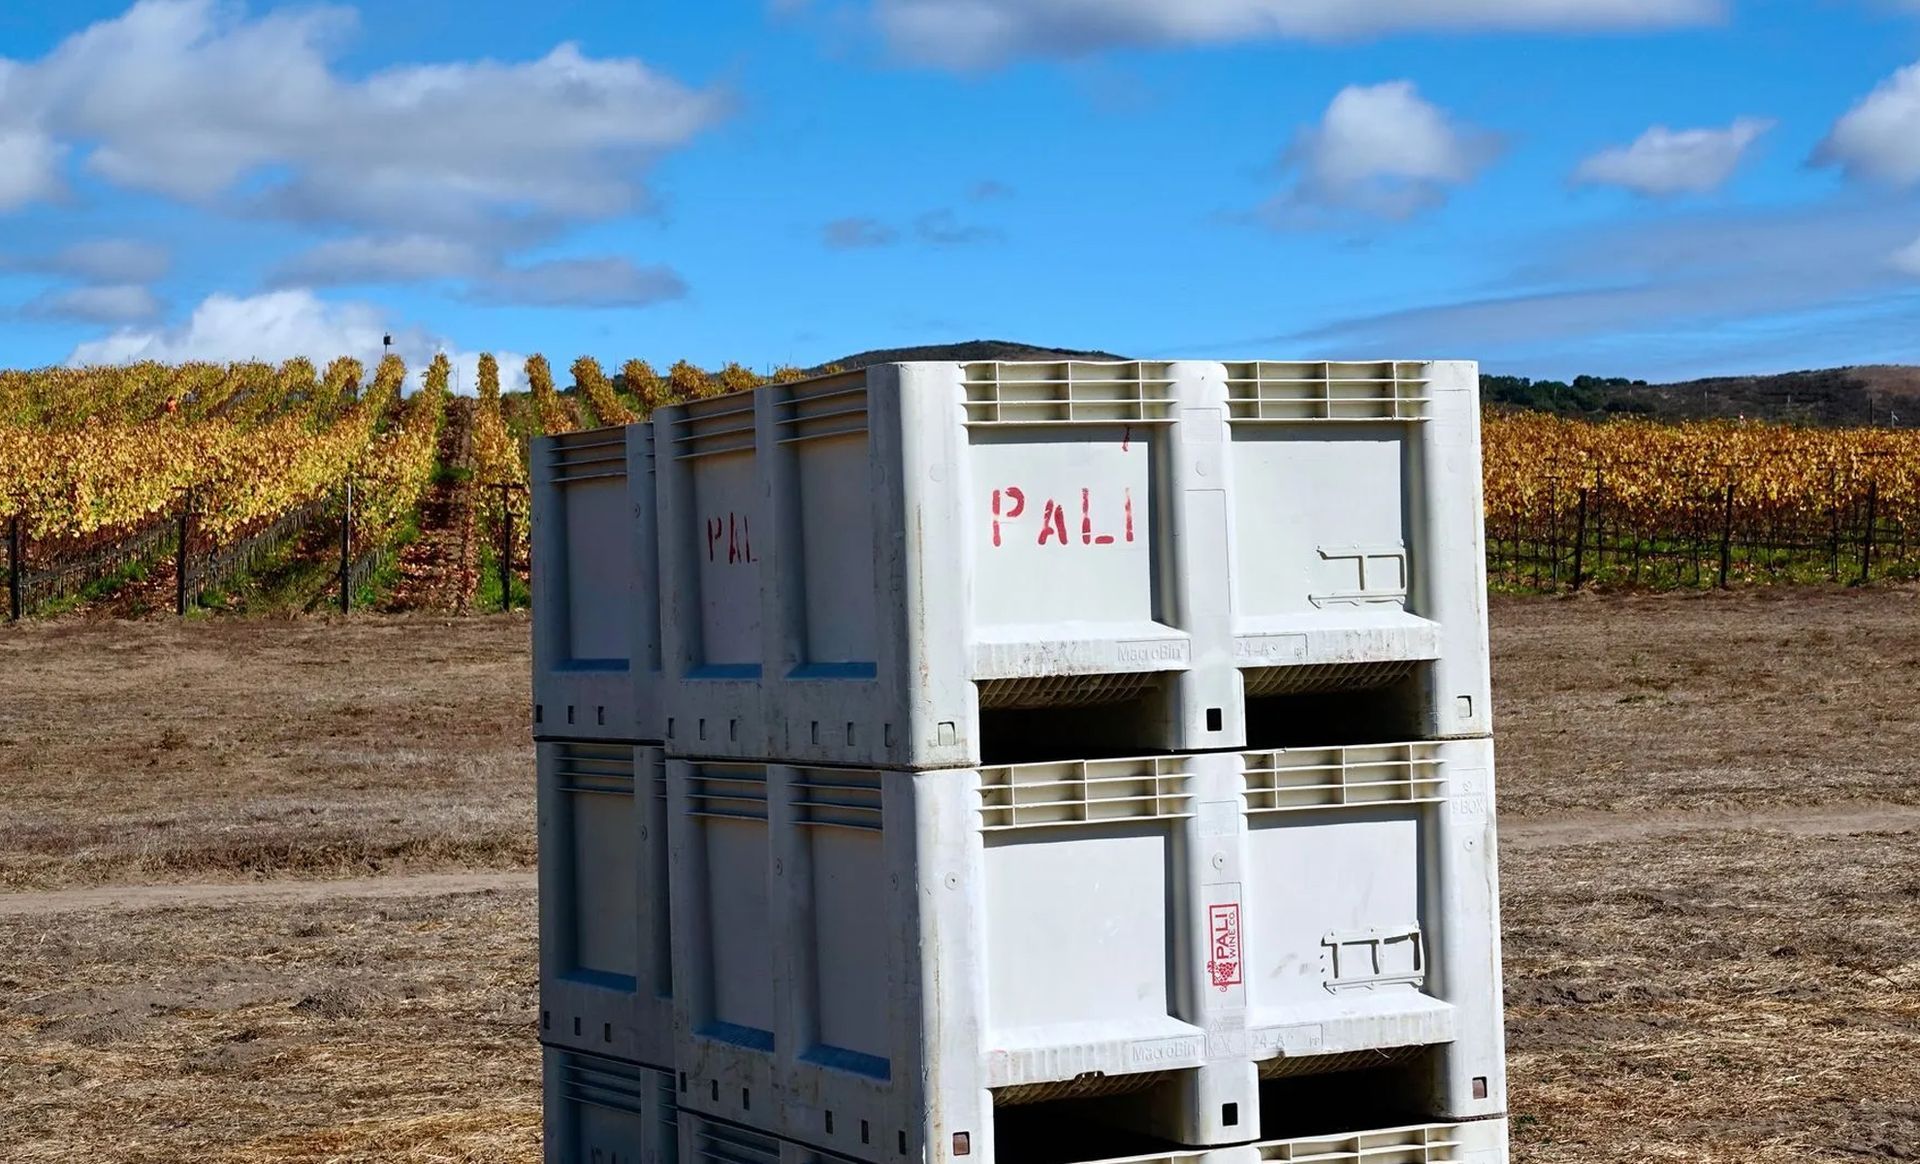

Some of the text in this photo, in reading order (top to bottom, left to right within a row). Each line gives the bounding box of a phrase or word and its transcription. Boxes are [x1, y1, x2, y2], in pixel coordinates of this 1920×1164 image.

[991, 486, 1135, 547] PALI
[1215, 913, 1229, 960] PALI
[1228, 928, 1237, 959] WINE
